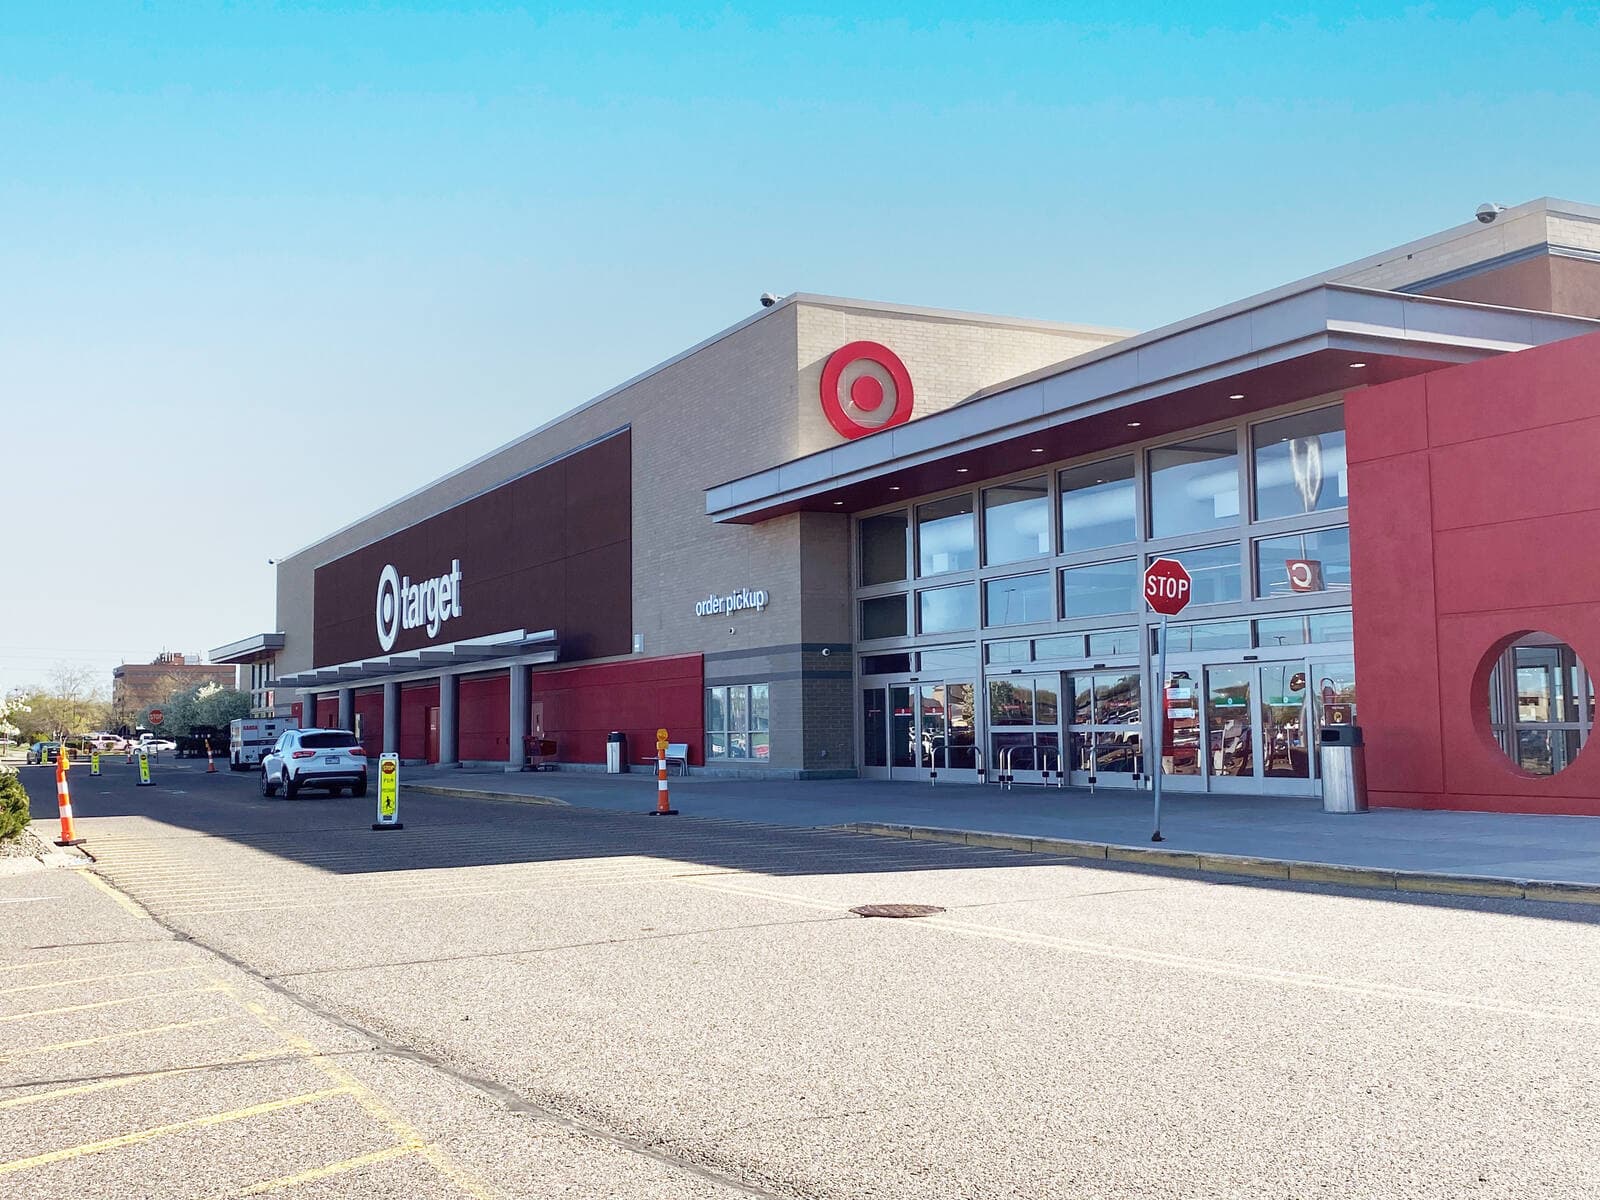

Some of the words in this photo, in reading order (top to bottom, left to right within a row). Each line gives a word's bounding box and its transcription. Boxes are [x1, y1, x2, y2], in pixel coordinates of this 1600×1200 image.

[401, 559, 462, 638] target
[1147, 575, 1189, 599] STOP
[696, 594, 724, 616] order
[726, 588, 766, 616] pickup
